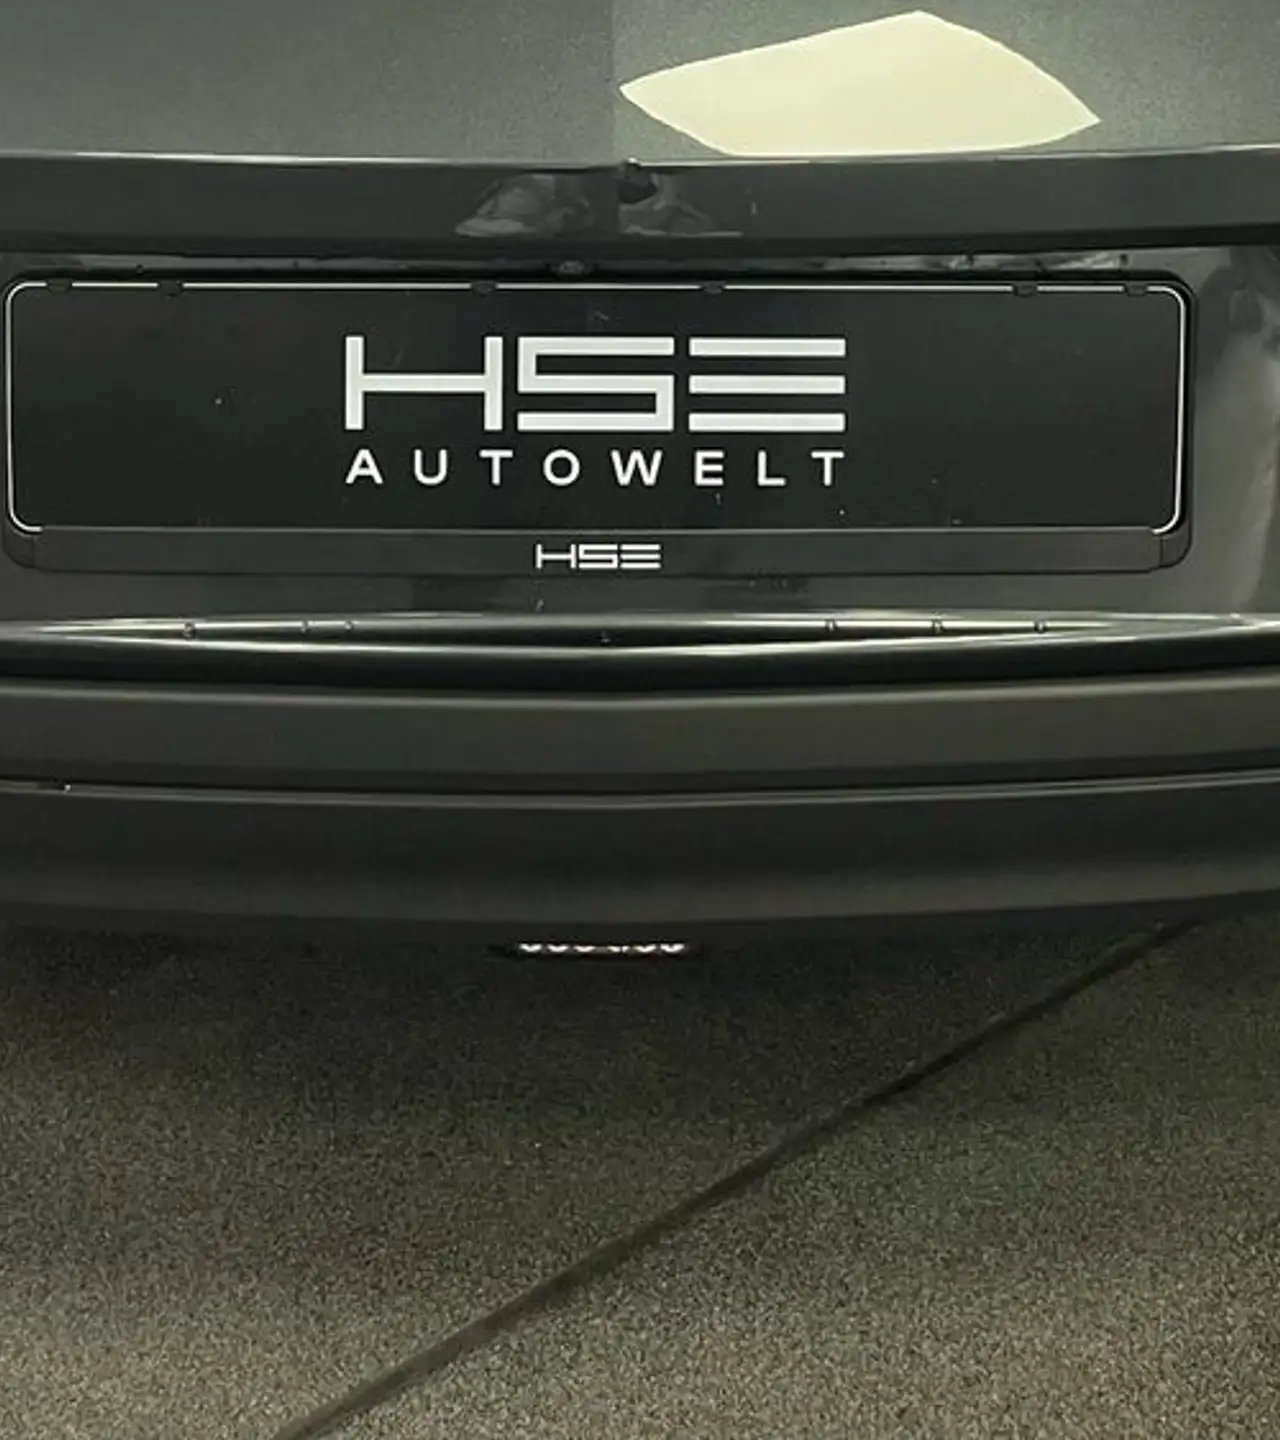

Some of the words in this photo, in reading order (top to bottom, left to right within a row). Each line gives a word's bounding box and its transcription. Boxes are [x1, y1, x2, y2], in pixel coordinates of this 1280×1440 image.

[345, 336, 846, 432] HSE
[345, 448, 845, 487] AUTOWELT
[535, 543, 662, 570] HSE
